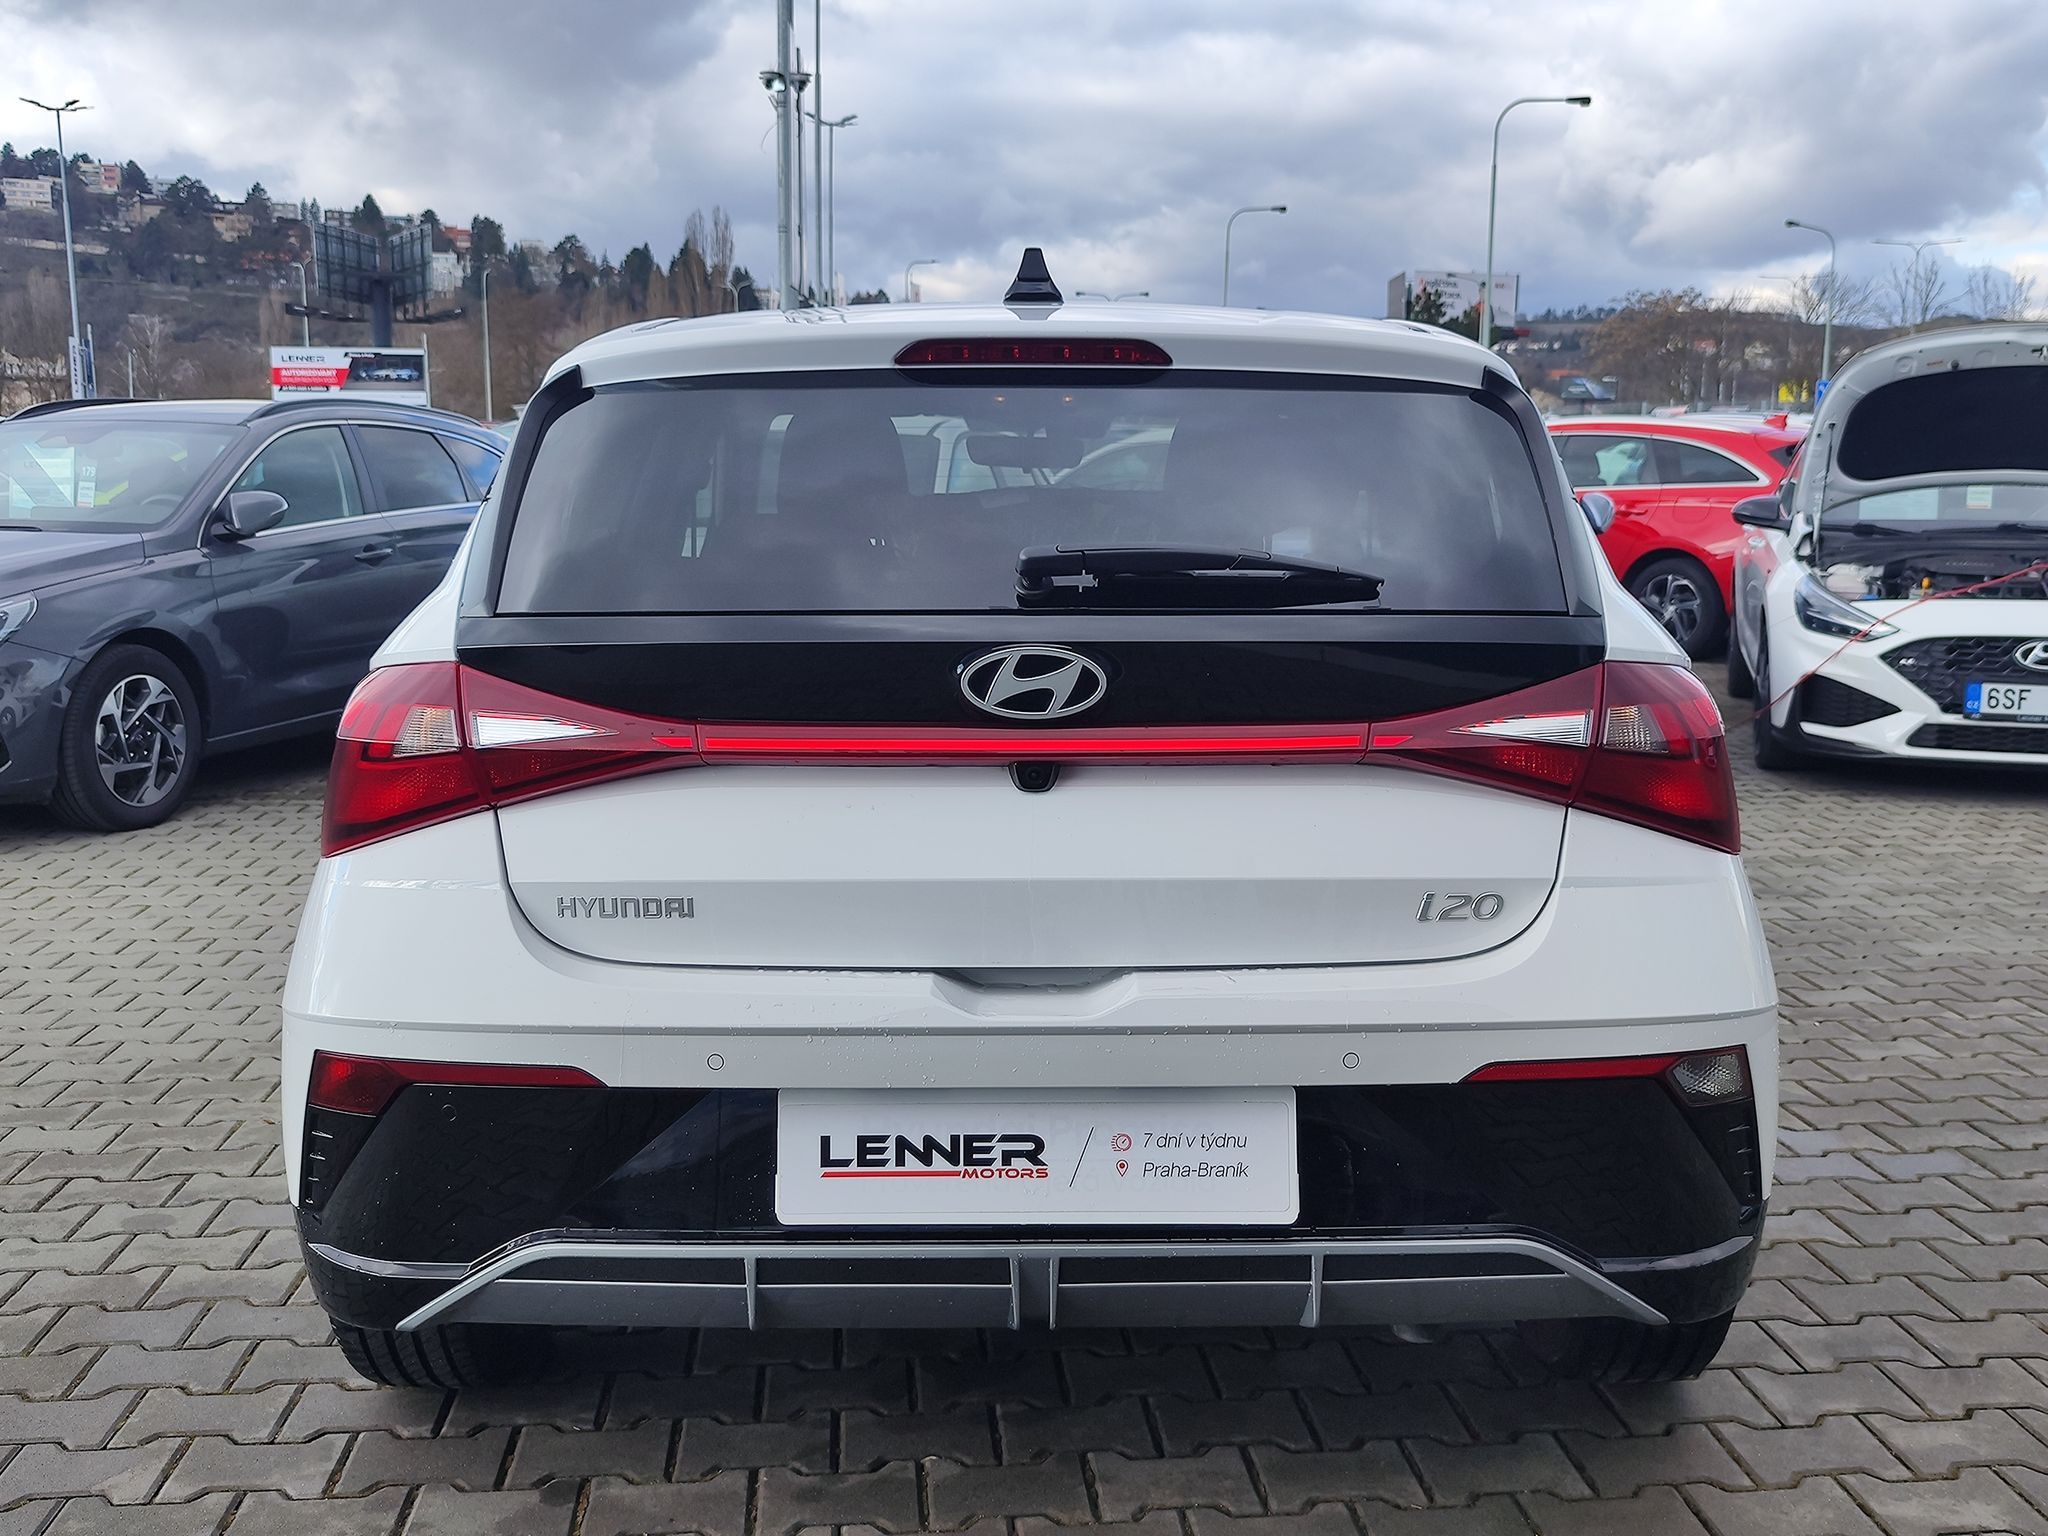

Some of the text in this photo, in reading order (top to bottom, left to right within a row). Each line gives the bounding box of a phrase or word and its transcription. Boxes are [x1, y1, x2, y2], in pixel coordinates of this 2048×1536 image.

[1987, 687, 2031, 710] 6SF
[557, 896, 695, 919] HYUNDAI
[1416, 891, 1504, 921] i20
[820, 1134, 1048, 1168] LENNER
[1143, 1132, 1248, 1153] 7 dní v týdnu
[962, 1168, 1048, 1179] MOTORS
[1143, 1161, 1249, 1179] Praha-Braník
